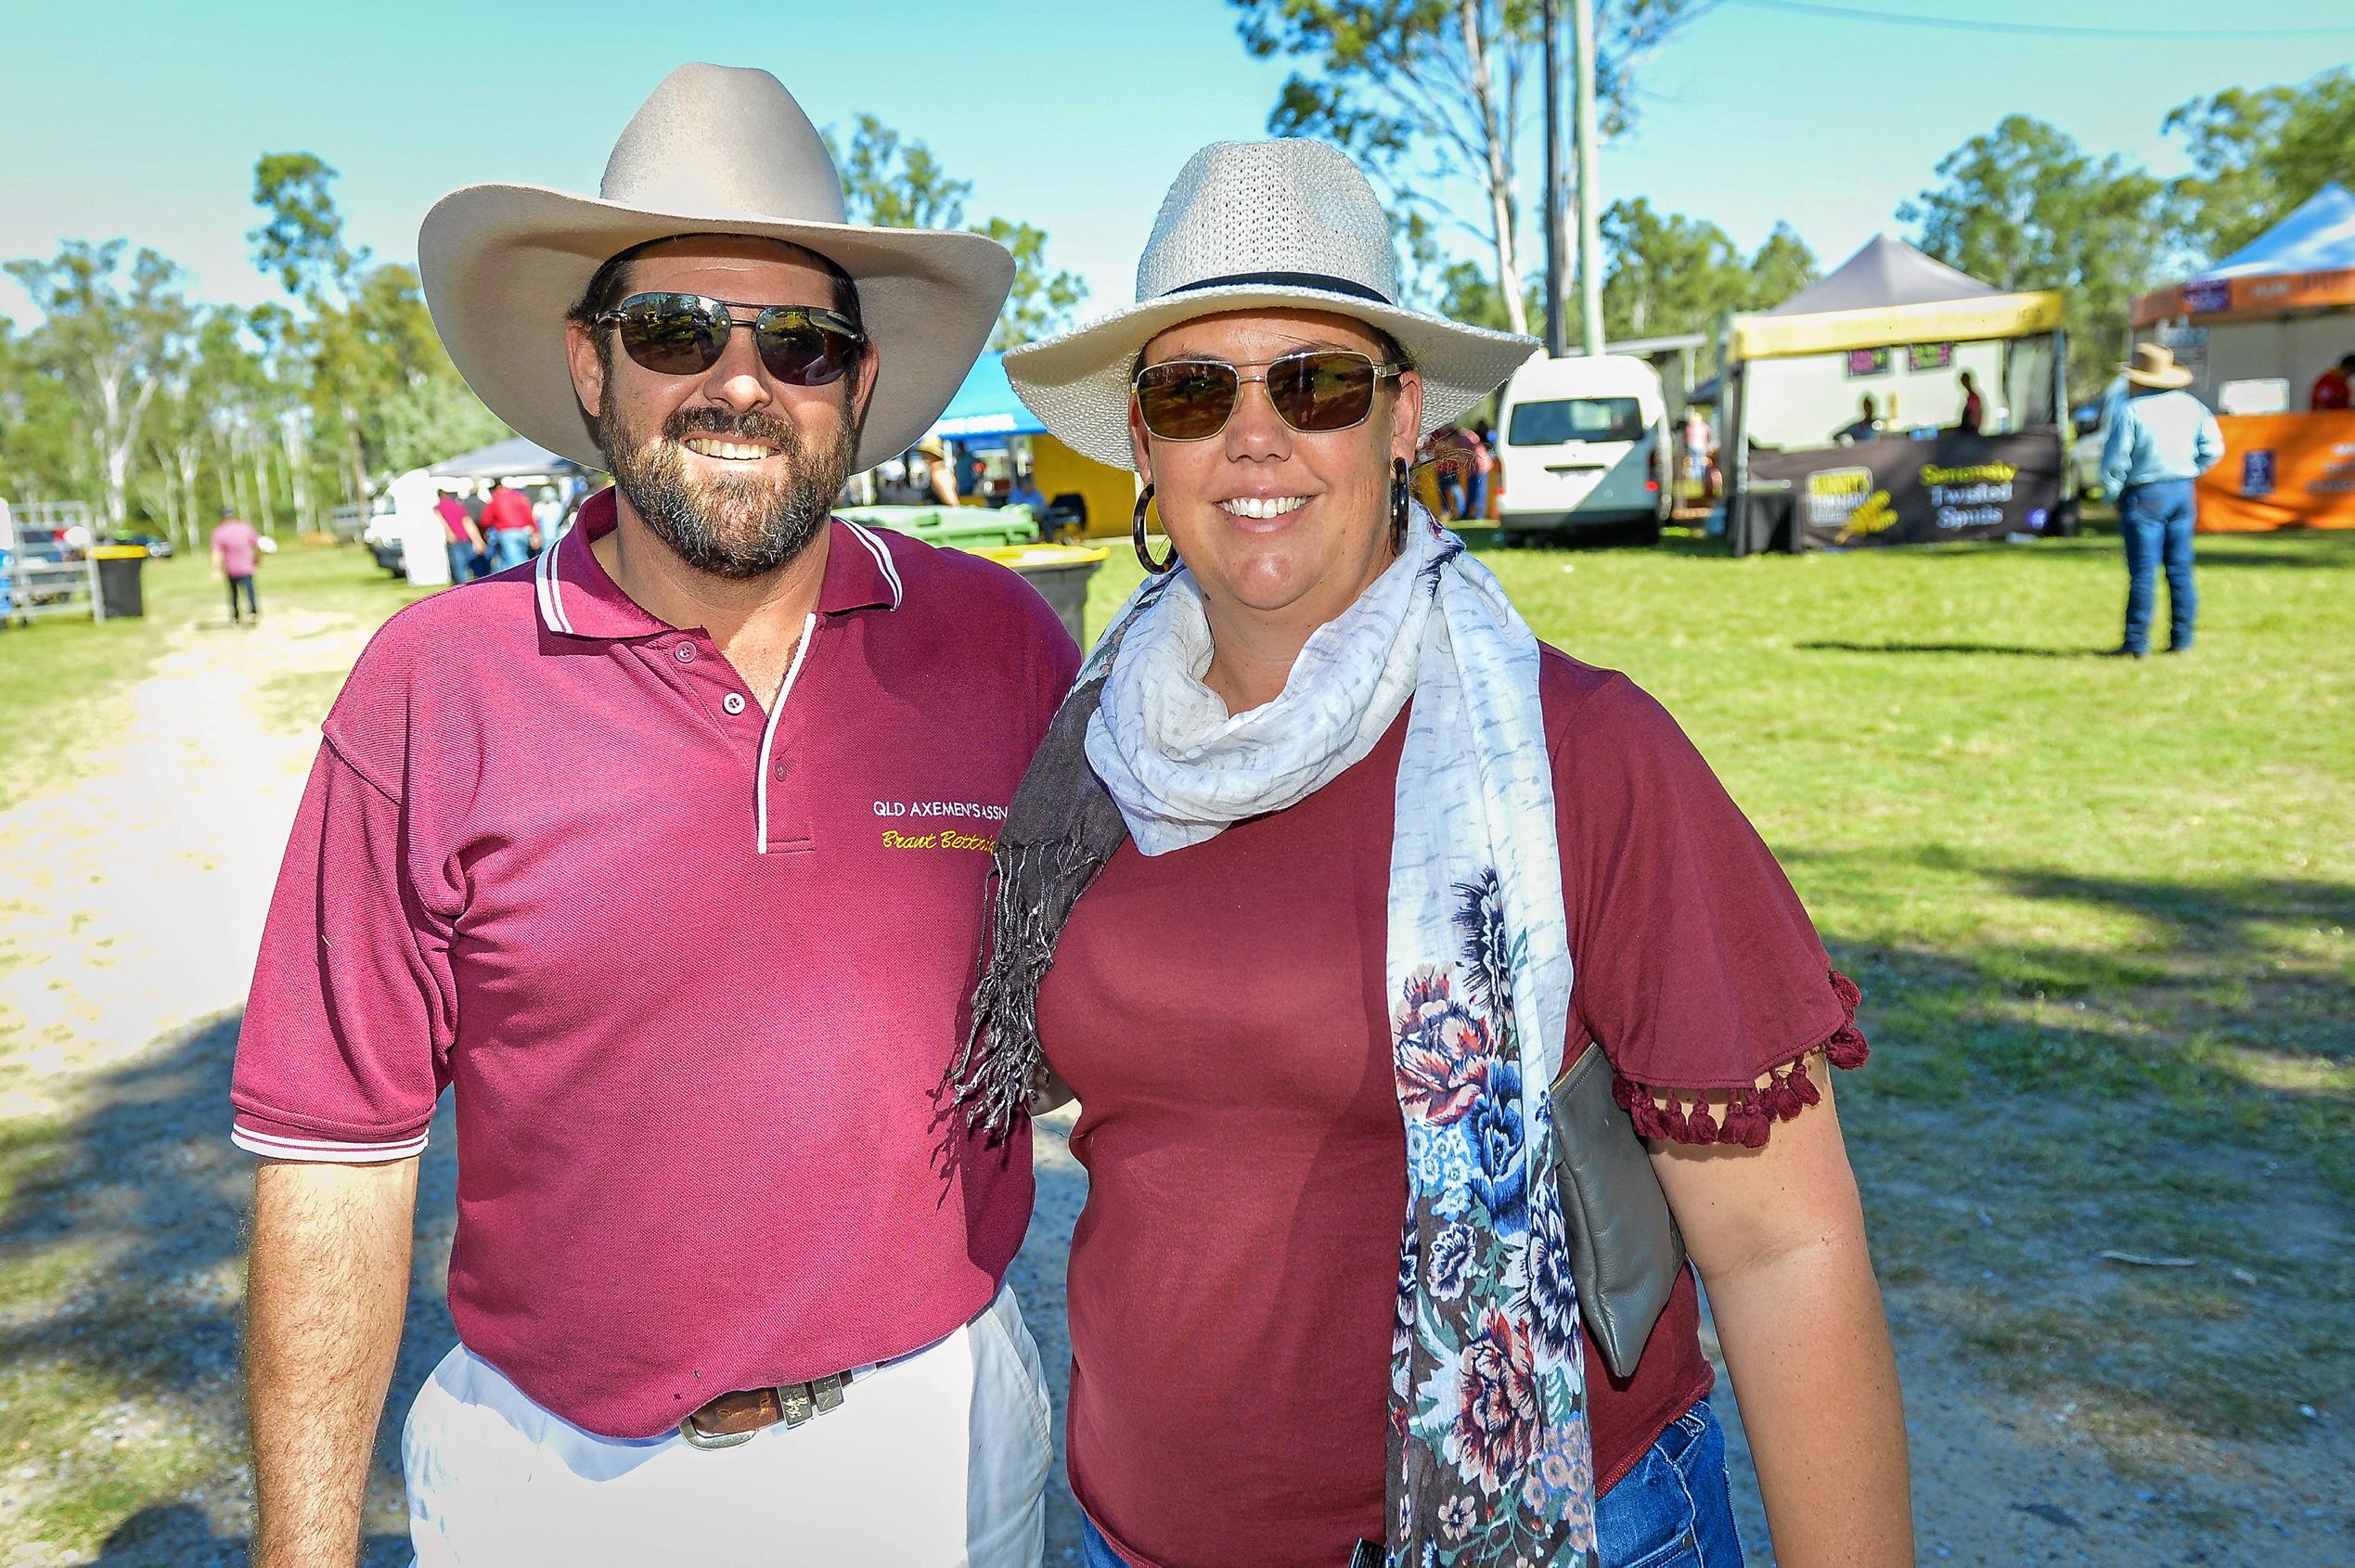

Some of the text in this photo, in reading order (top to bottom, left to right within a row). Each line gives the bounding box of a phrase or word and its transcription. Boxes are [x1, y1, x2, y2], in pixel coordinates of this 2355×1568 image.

[873, 801, 906, 816] QLD
[909, 802, 981, 817] AXEMEN'S
[882, 830, 936, 849] Brant
